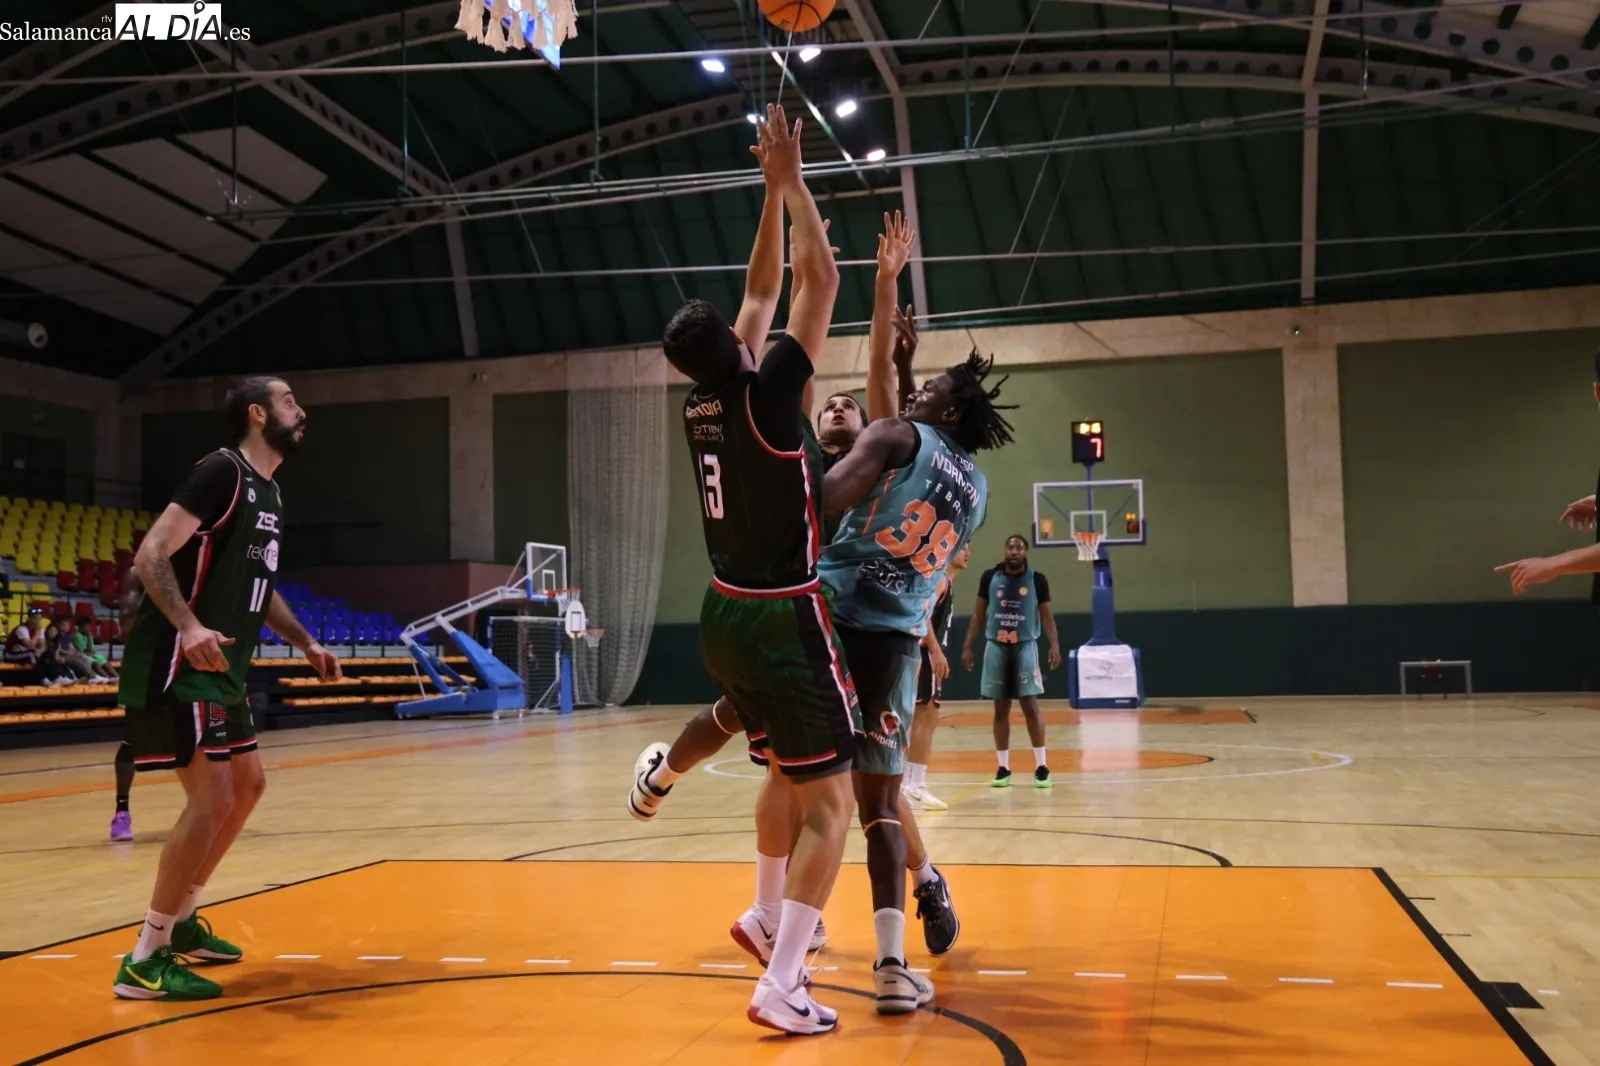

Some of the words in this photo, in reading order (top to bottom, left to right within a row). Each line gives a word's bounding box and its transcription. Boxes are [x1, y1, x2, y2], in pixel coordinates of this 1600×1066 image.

[1090, 438, 1102, 458] 7
[699, 453, 724, 519] 13
[875, 499, 959, 579] 38
[249, 577, 268, 612] 11
